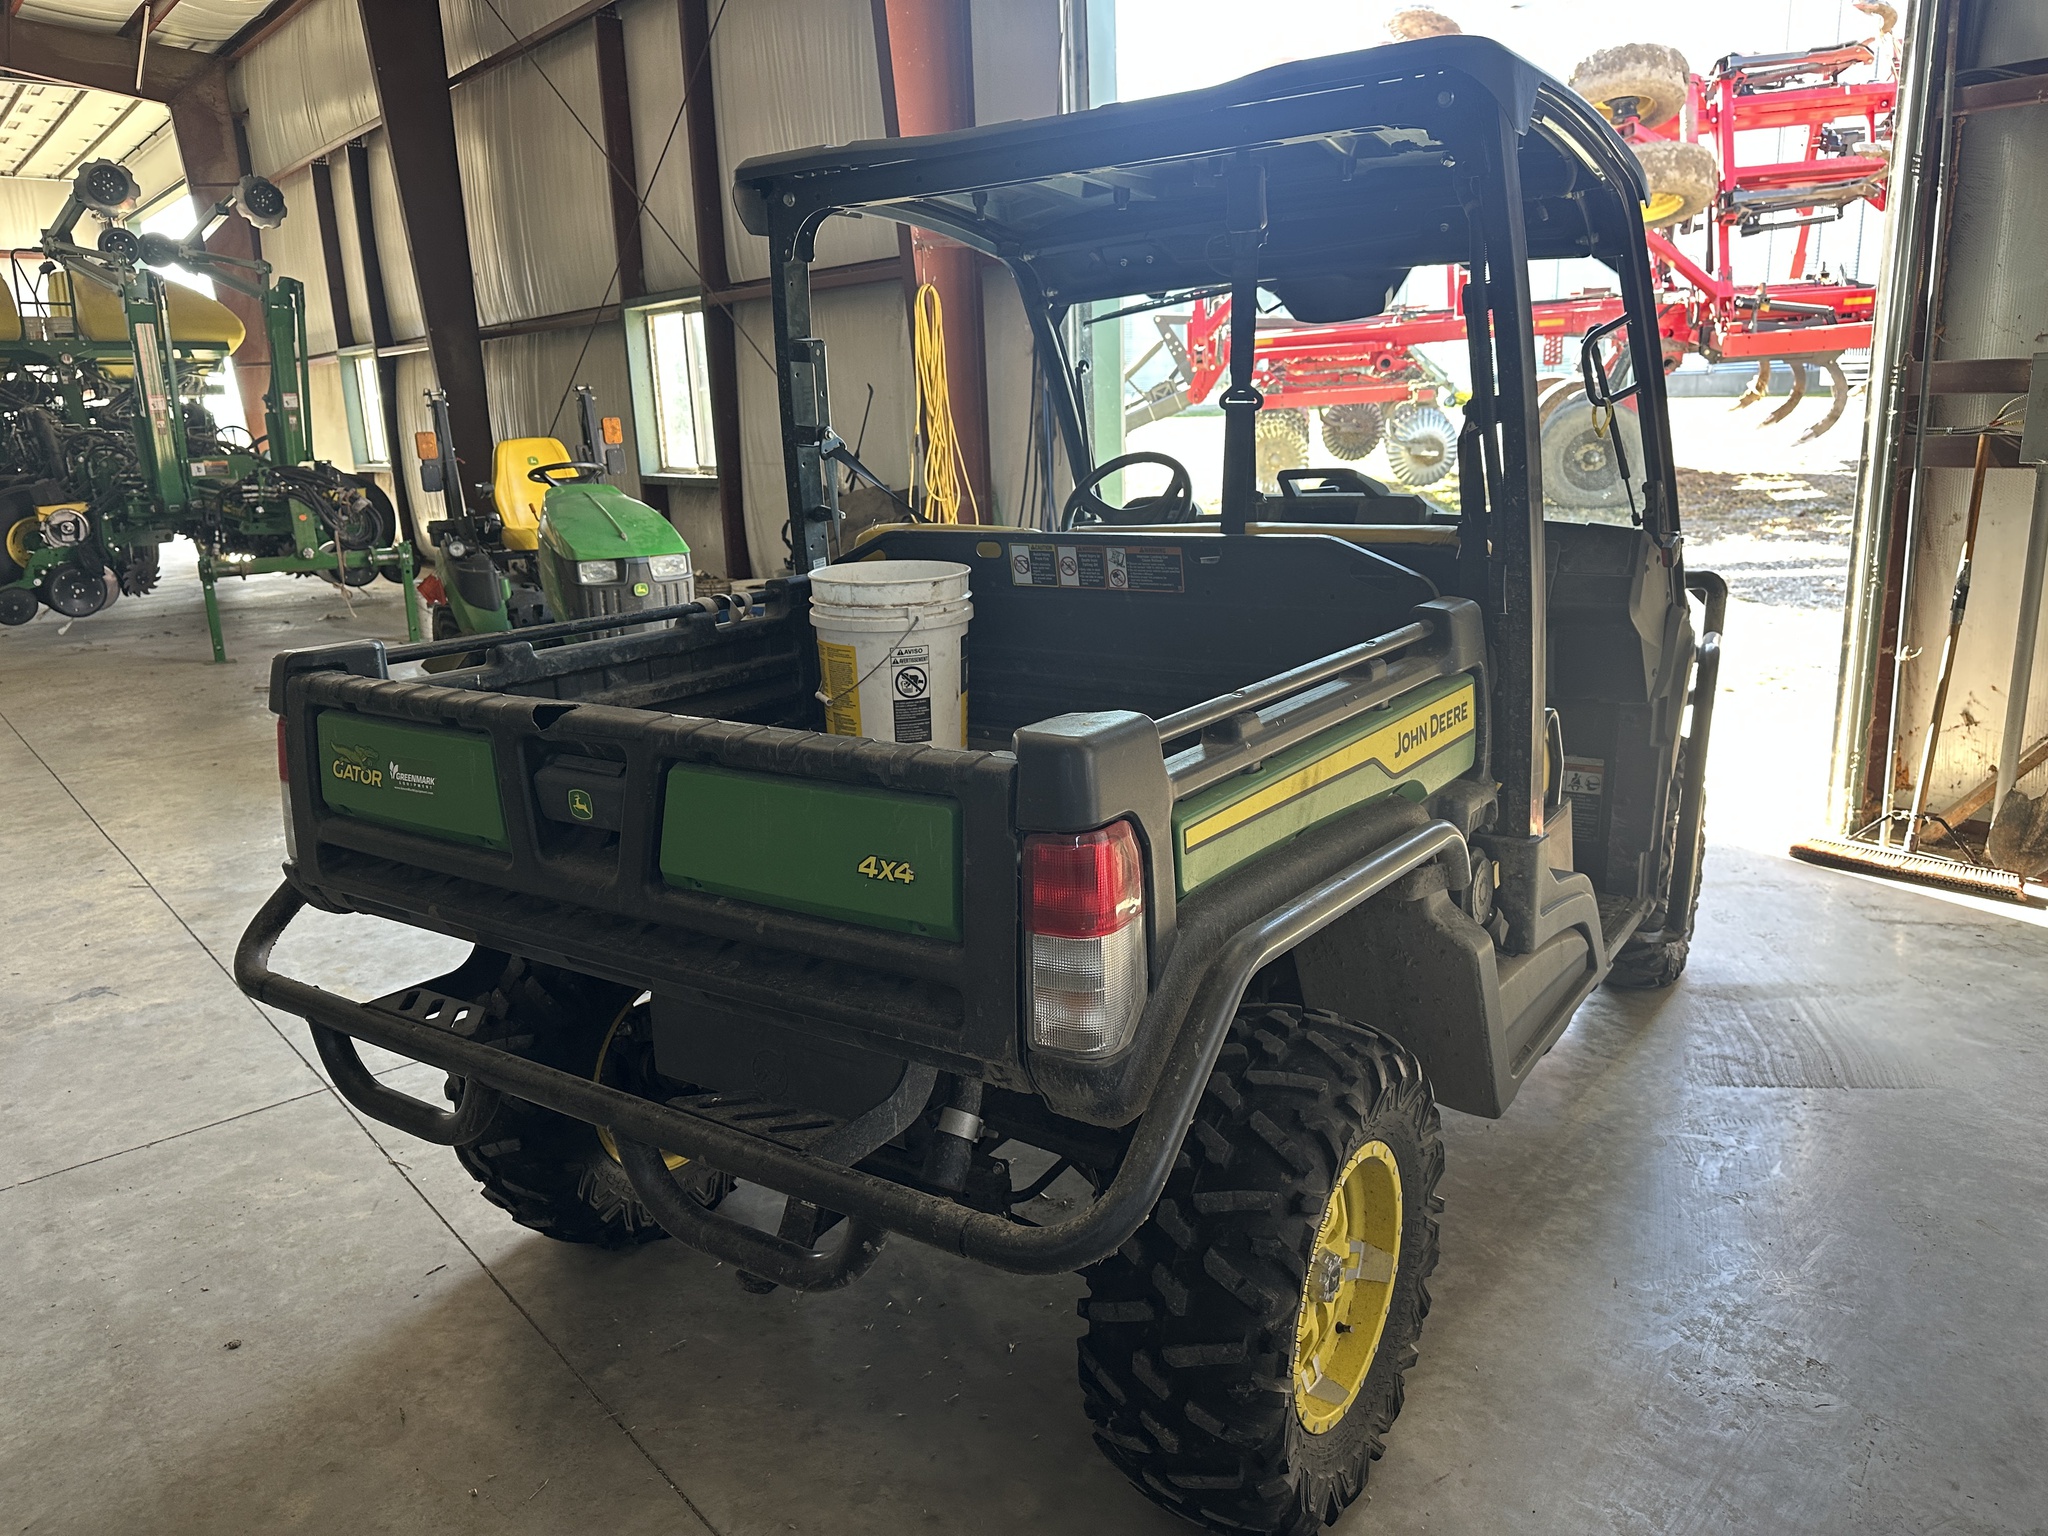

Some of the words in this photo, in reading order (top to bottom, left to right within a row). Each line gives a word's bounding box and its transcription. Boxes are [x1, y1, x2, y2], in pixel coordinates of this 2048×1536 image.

[903, 647, 923, 655] AVISO
[1394, 722, 1428, 759] JOHN
[1429, 700, 1468, 739] DEERE
[332, 759, 383, 788] GATOR
[395, 772, 435, 786] GREENMARK
